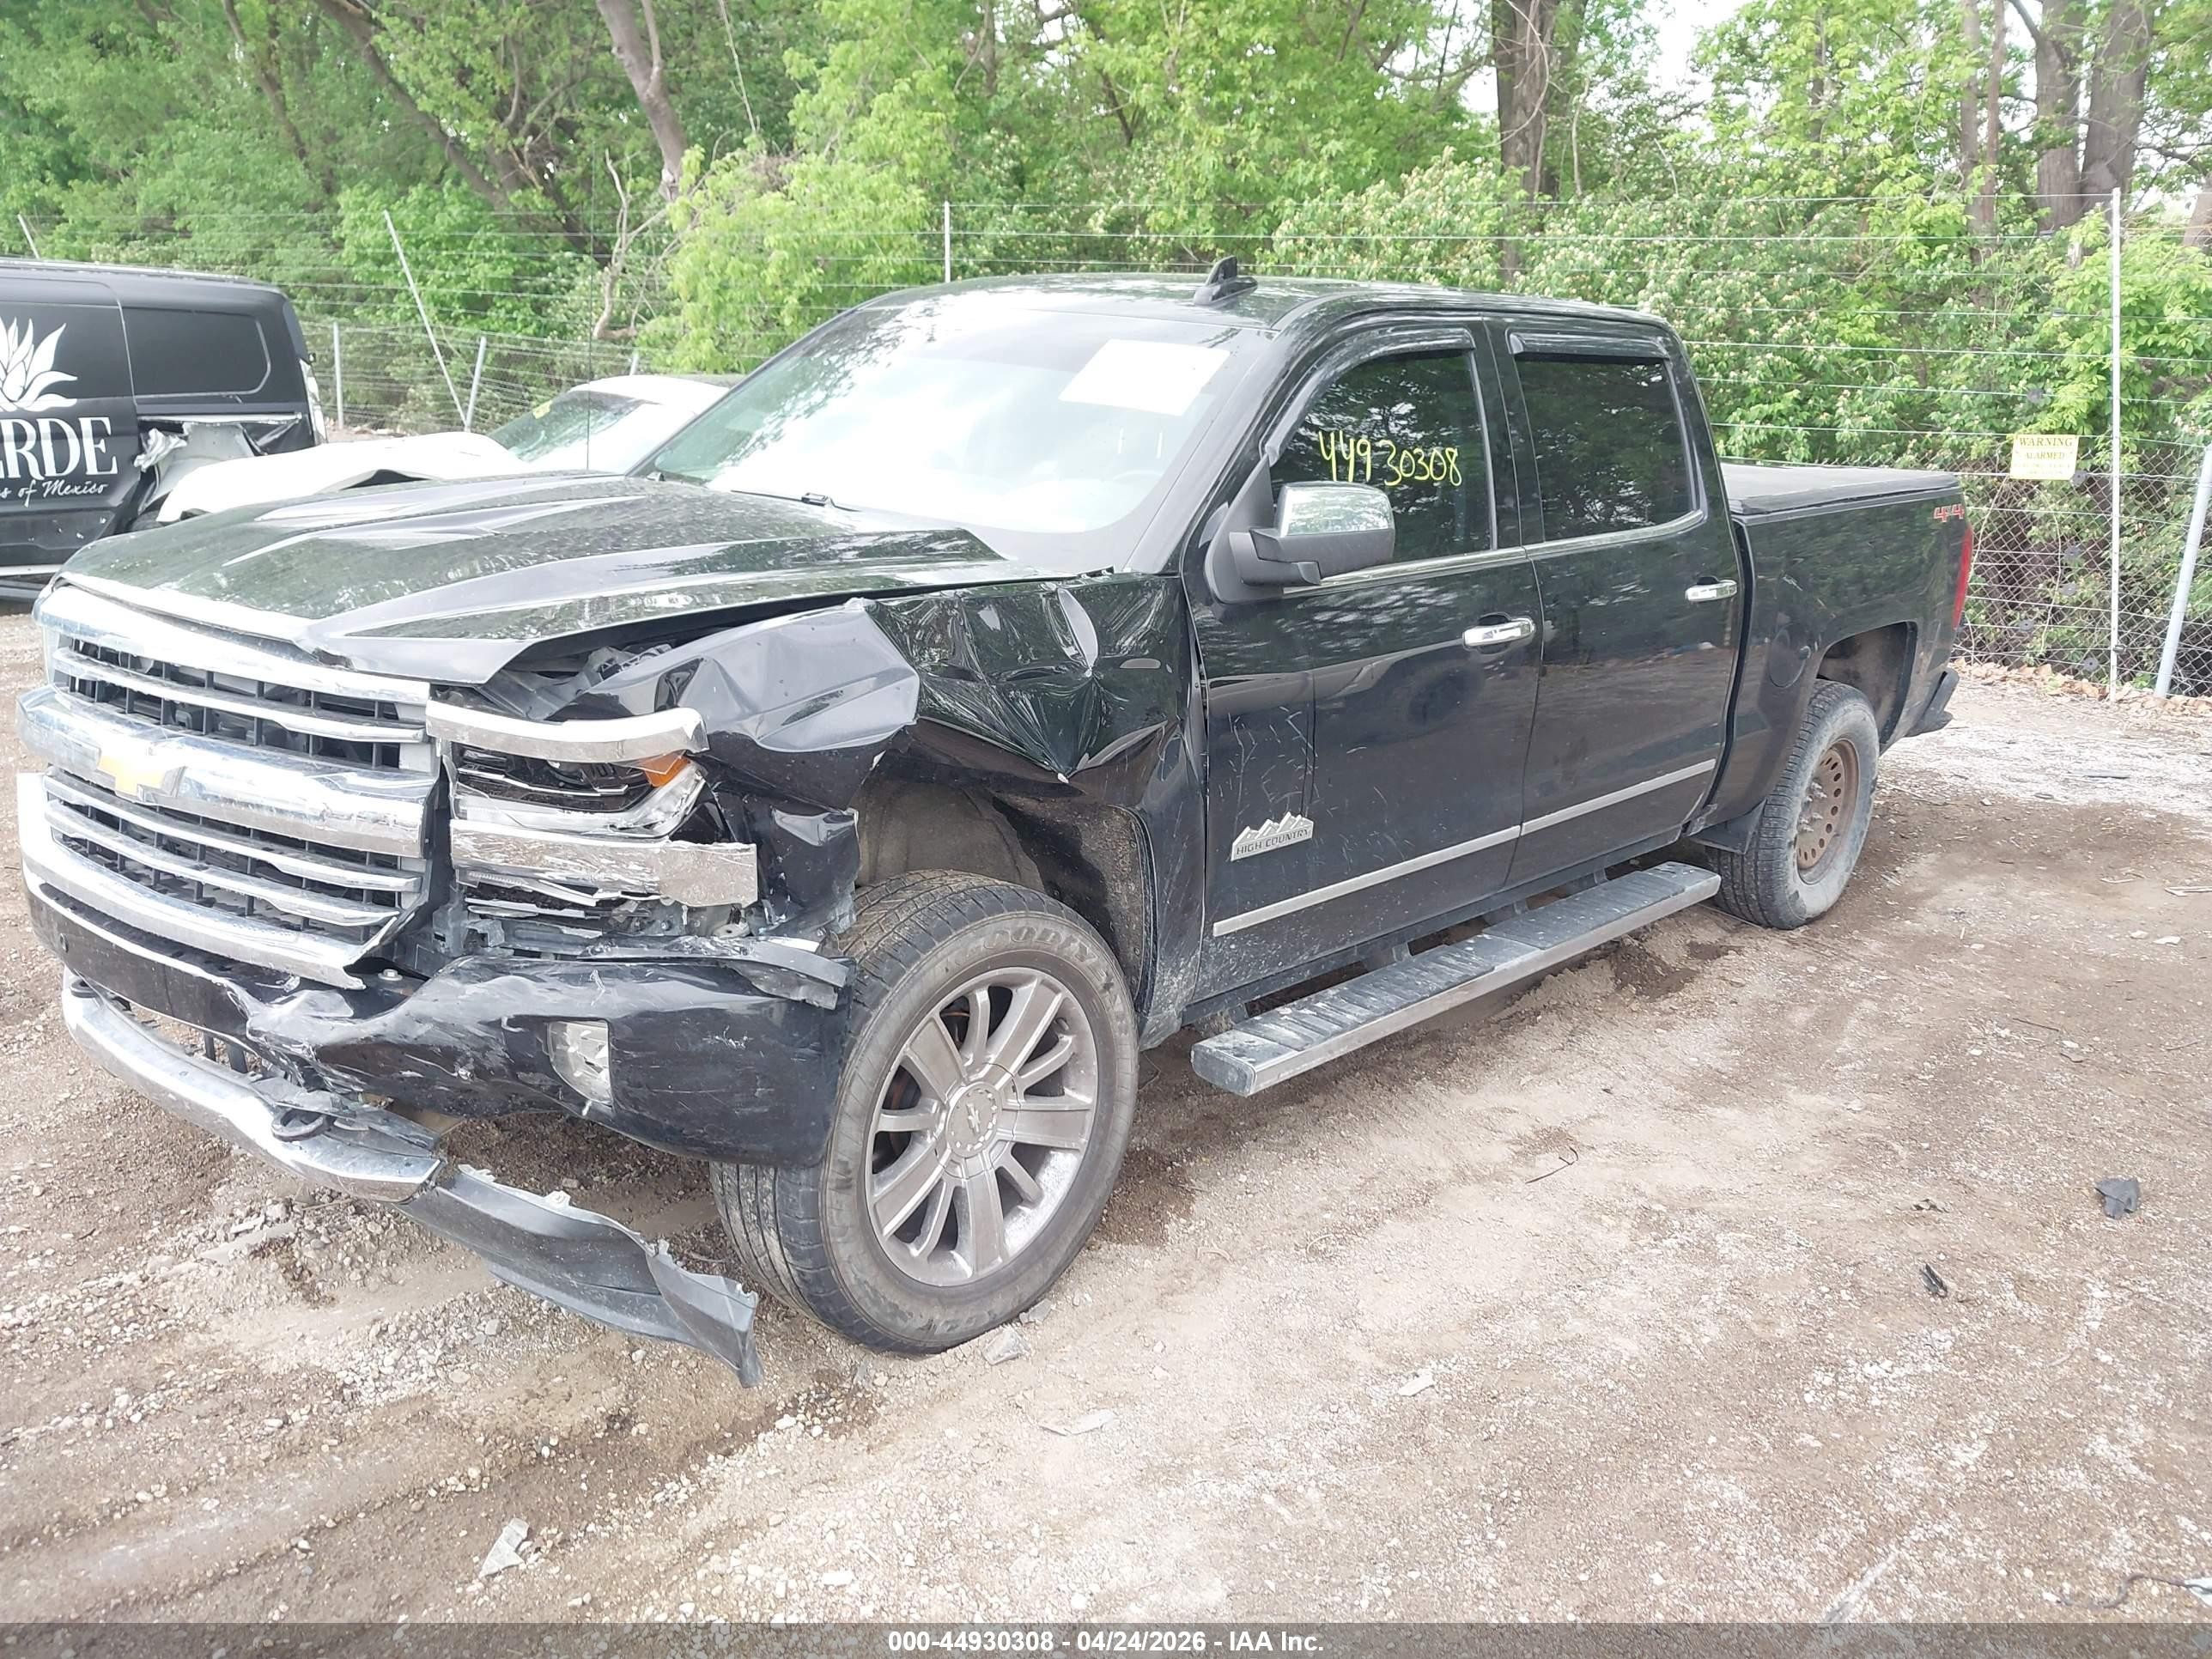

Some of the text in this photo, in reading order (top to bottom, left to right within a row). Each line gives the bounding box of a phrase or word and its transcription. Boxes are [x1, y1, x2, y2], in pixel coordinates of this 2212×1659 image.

[0, 417, 118, 481] RDE
[2020, 437, 2073, 447] WARNING
[1318, 429, 1462, 487] 44930308
[17, 478, 38, 508] of
[42, 478, 109, 498] Mexico
[1237, 829, 1309, 855] HIGH COUNTRY
